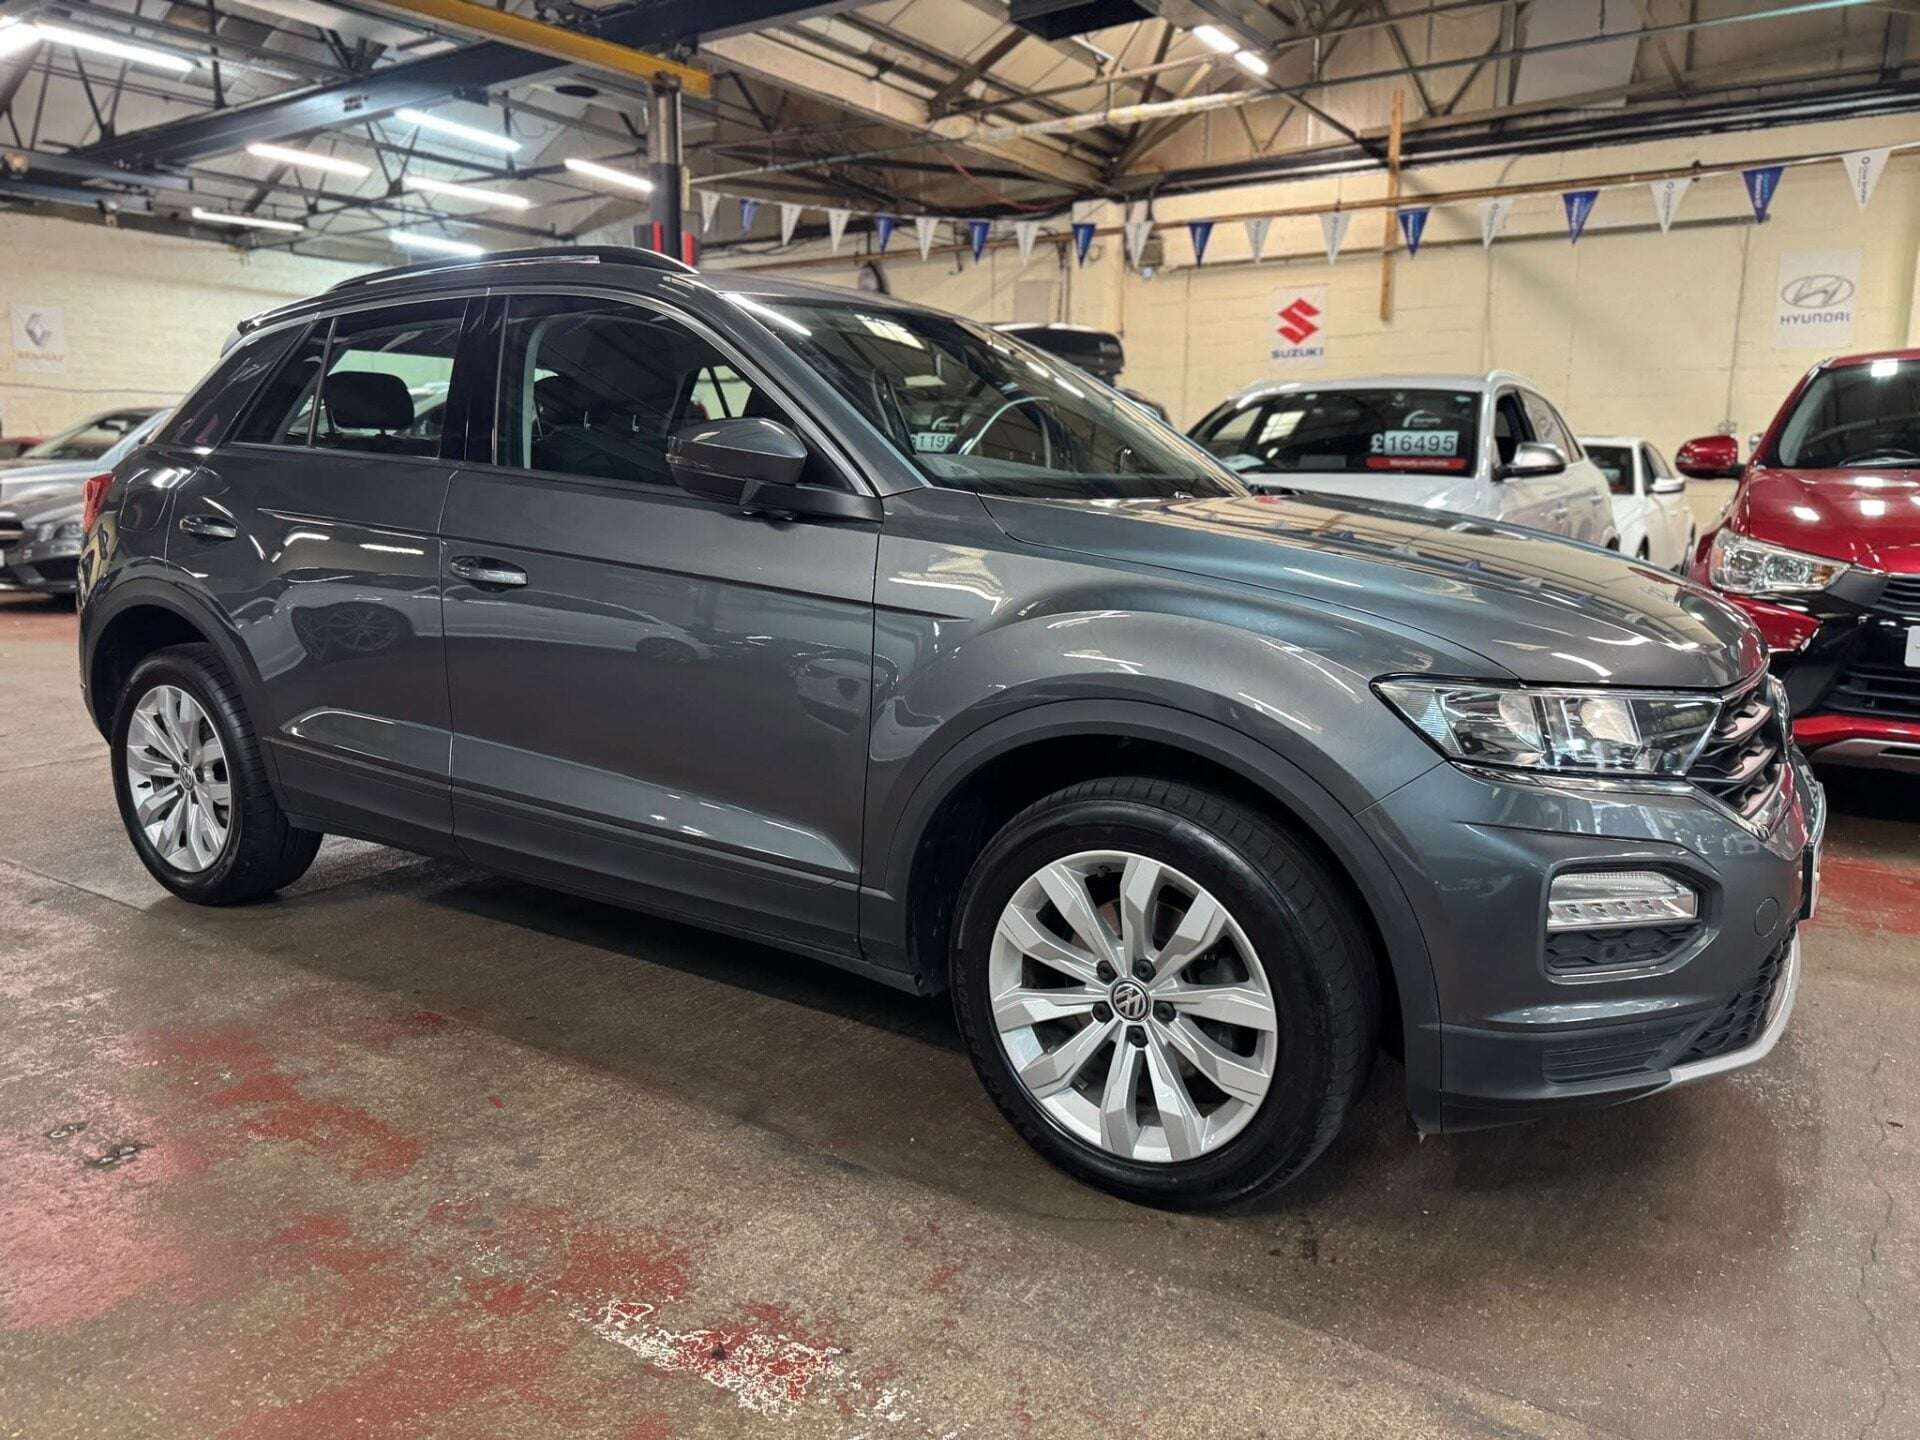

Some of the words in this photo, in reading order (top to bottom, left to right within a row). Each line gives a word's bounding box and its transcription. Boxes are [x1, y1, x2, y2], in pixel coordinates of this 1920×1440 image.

[1780, 311, 1850, 325] HYUNDAI
[1271, 347, 1324, 359] SUZUKI
[1369, 433, 1455, 453] £16495
